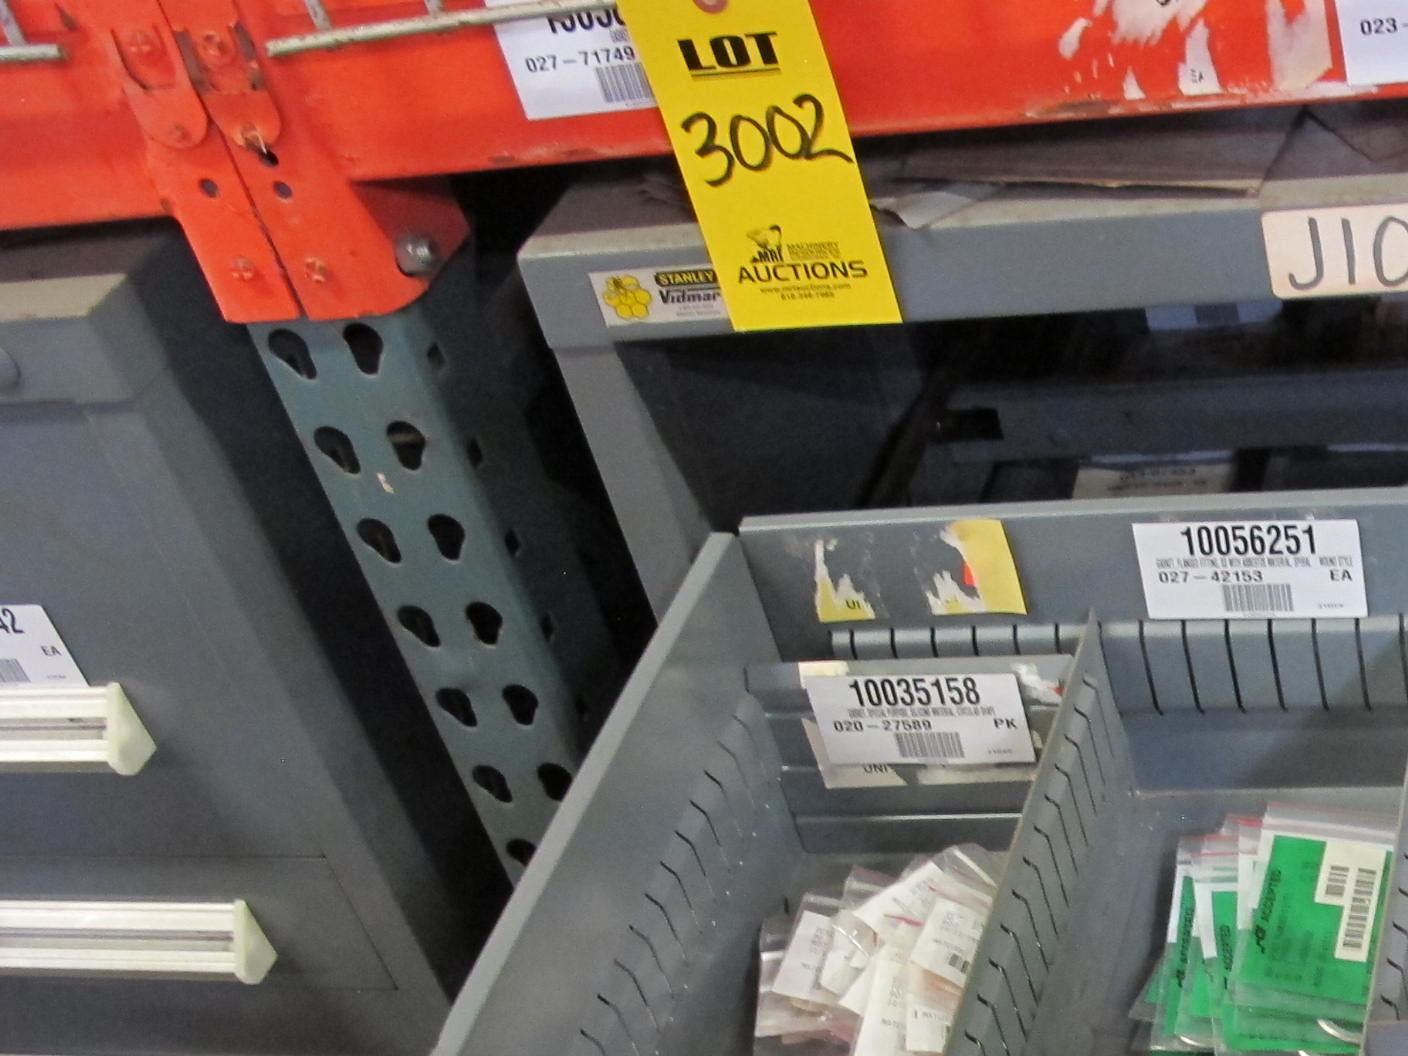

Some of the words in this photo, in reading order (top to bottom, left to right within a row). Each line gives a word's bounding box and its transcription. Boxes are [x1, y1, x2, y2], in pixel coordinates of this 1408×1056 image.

[677, 32, 778, 71] LOT
[681, 94, 854, 187] 3002
[659, 271, 714, 284] STANLEY
[738, 260, 868, 284] AUCTIONS
[1181, 525, 1317, 556] 10056251
[1330, 569, 1353, 581] EA
[40, 646, 61, 656] EA
[850, 677, 981, 707] 10035158
[994, 718, 1018, 729] PK
